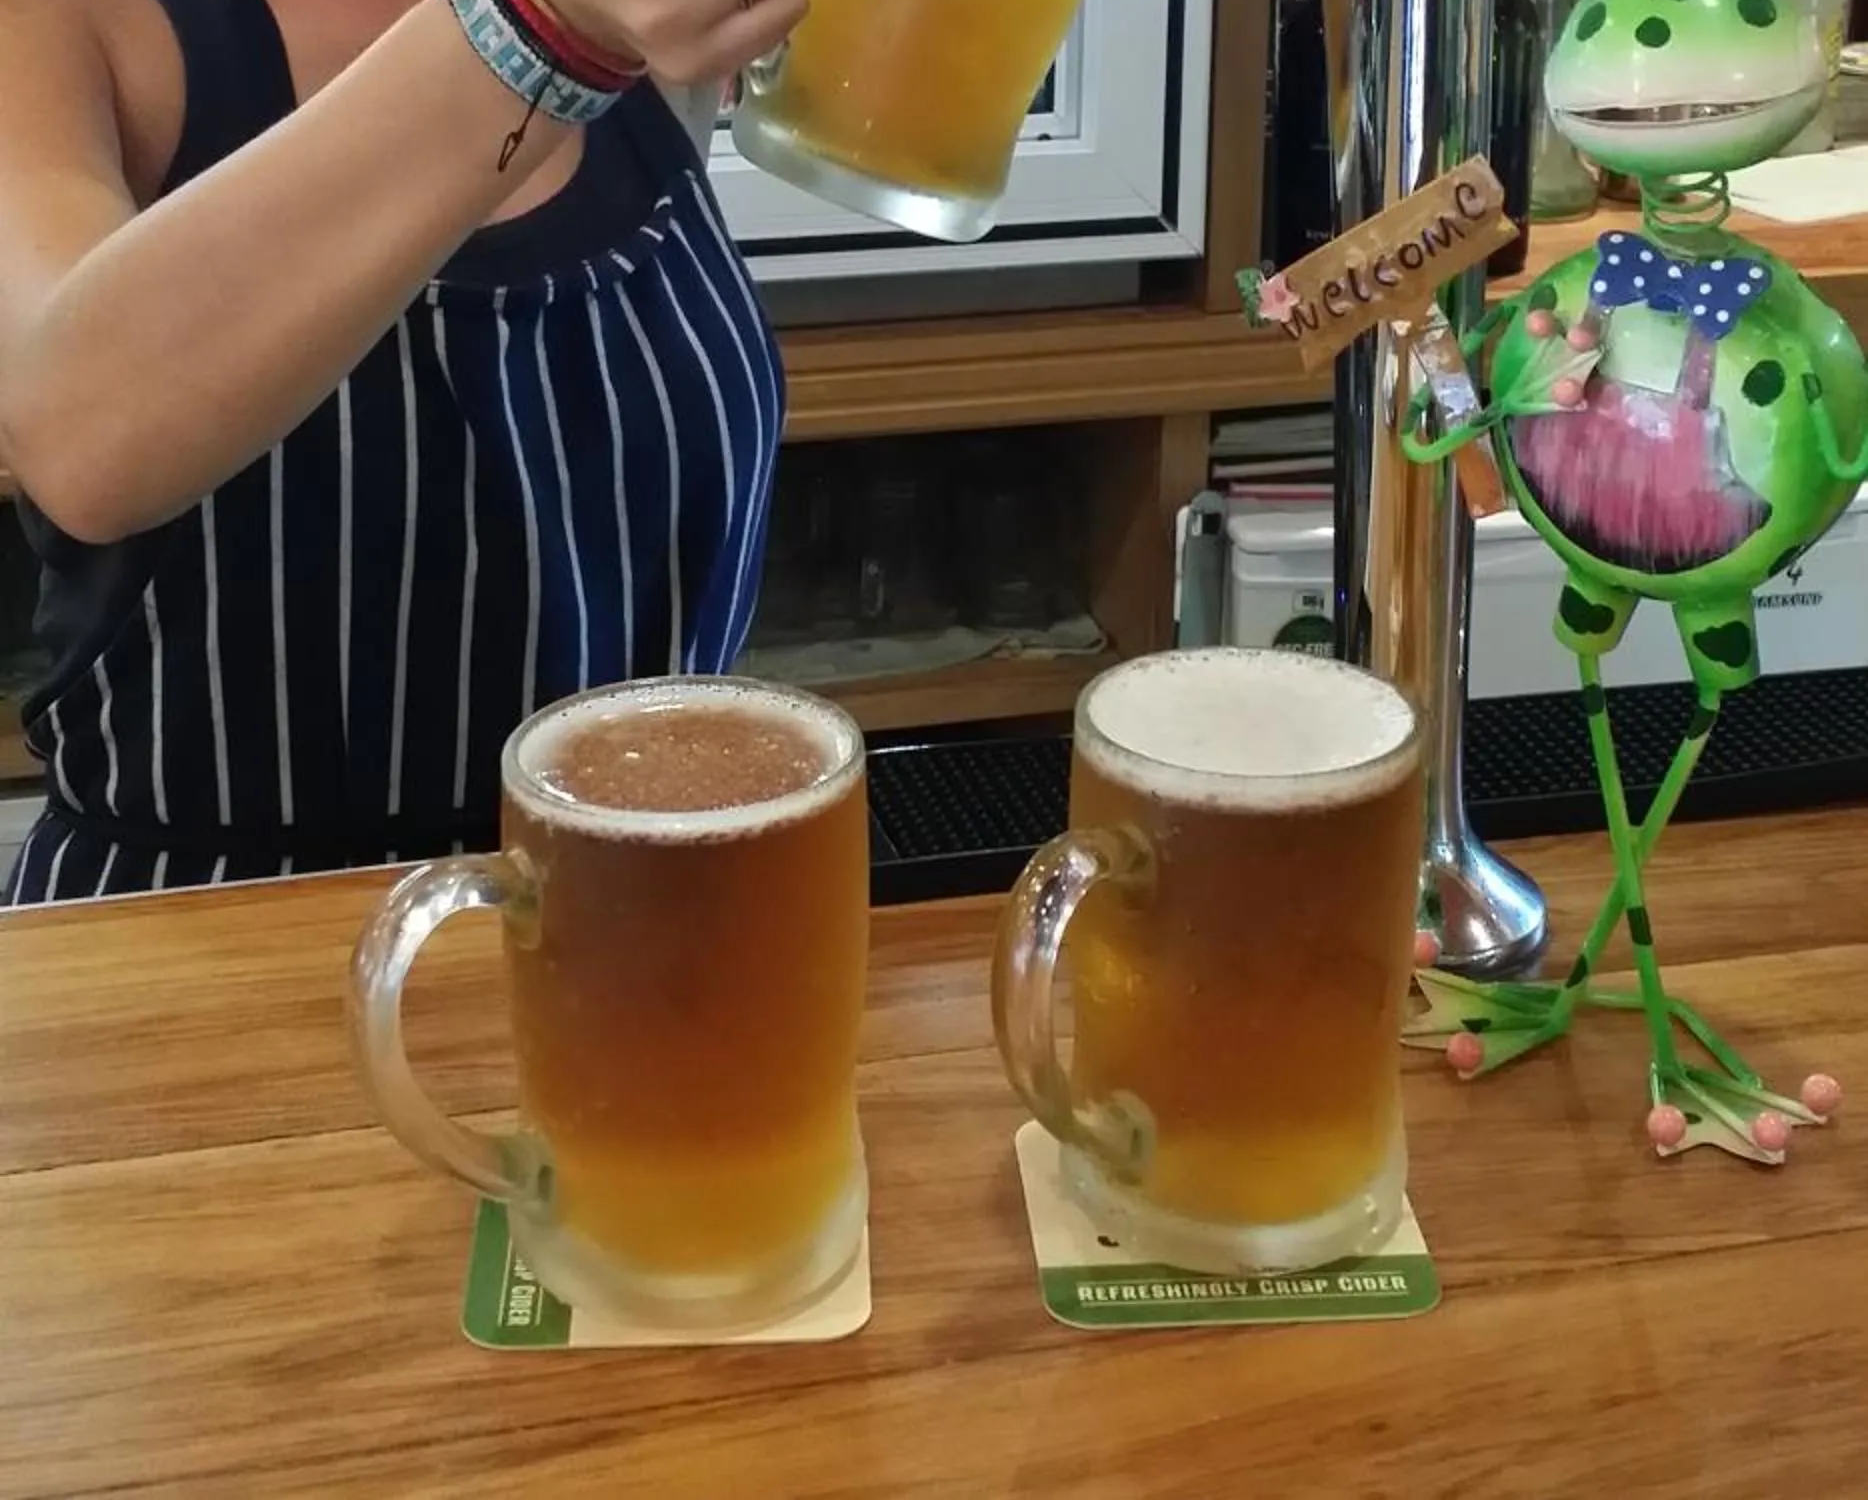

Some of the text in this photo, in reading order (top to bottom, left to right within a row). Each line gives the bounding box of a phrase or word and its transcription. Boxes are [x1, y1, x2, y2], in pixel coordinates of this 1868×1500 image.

[507, 1285, 536, 1327] CIDER
[1077, 1274, 1408, 1303] REFRESHINGLY CRISP CIDER
